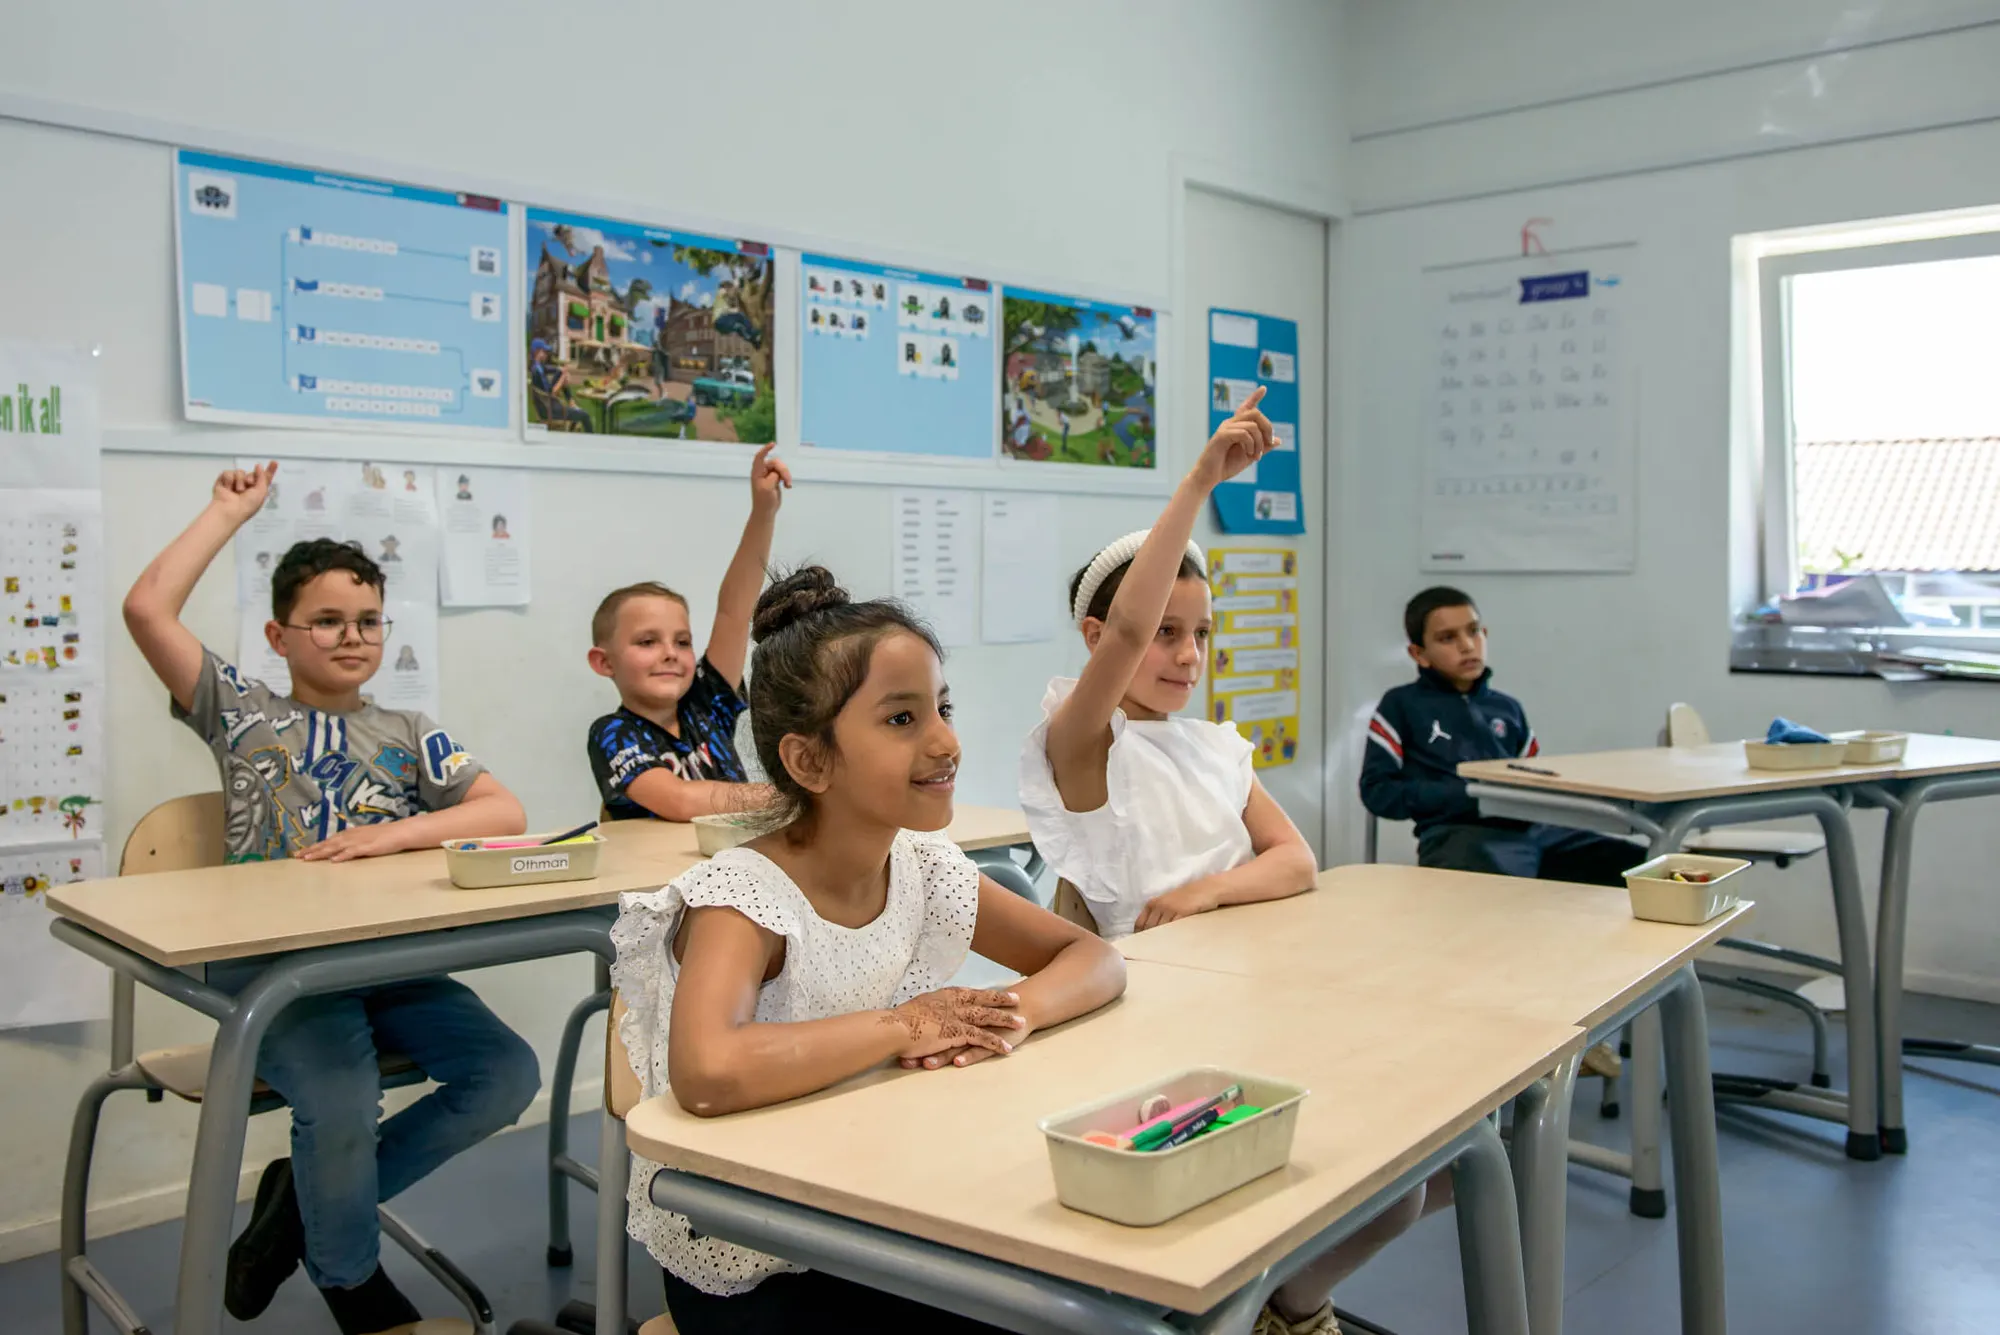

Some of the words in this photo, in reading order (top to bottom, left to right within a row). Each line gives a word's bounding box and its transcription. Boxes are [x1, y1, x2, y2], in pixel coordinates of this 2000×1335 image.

[0, 394, 13, 433] n
[18, 383, 36, 433] ik
[40, 384, 62, 435] al!
[513, 858, 568, 871] Othman
